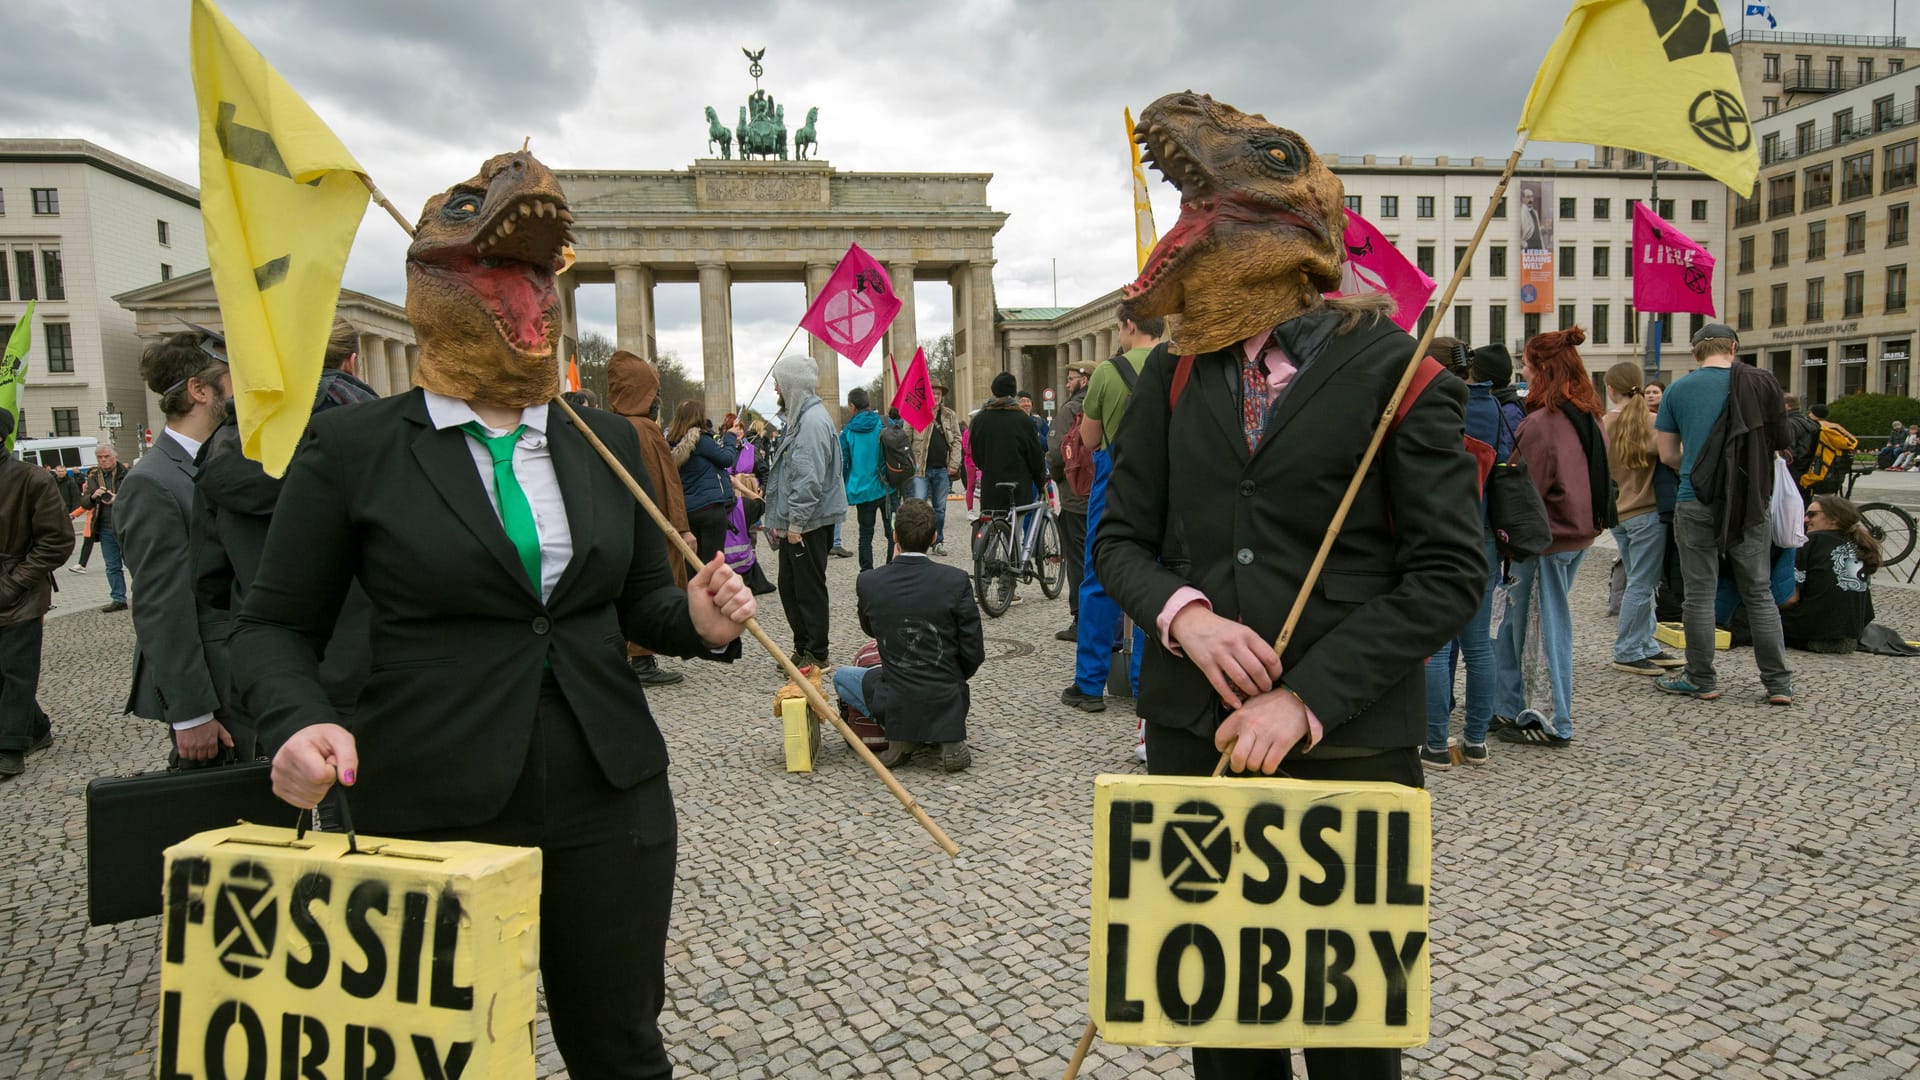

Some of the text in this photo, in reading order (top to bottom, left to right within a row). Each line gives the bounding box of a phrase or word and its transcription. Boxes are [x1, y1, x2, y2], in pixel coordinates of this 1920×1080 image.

[1523, 262, 1544, 270] WELT
[1643, 244, 1696, 268] LIEBE
[1795, 328, 1804, 337] AM
[1836, 321, 1858, 333] PLATZ
[1884, 351, 1904, 359] mama
[1108, 800, 1424, 907] FOSSIL
[165, 856, 474, 1011] FOSSIL
[1105, 922, 1427, 1026] LOBBY
